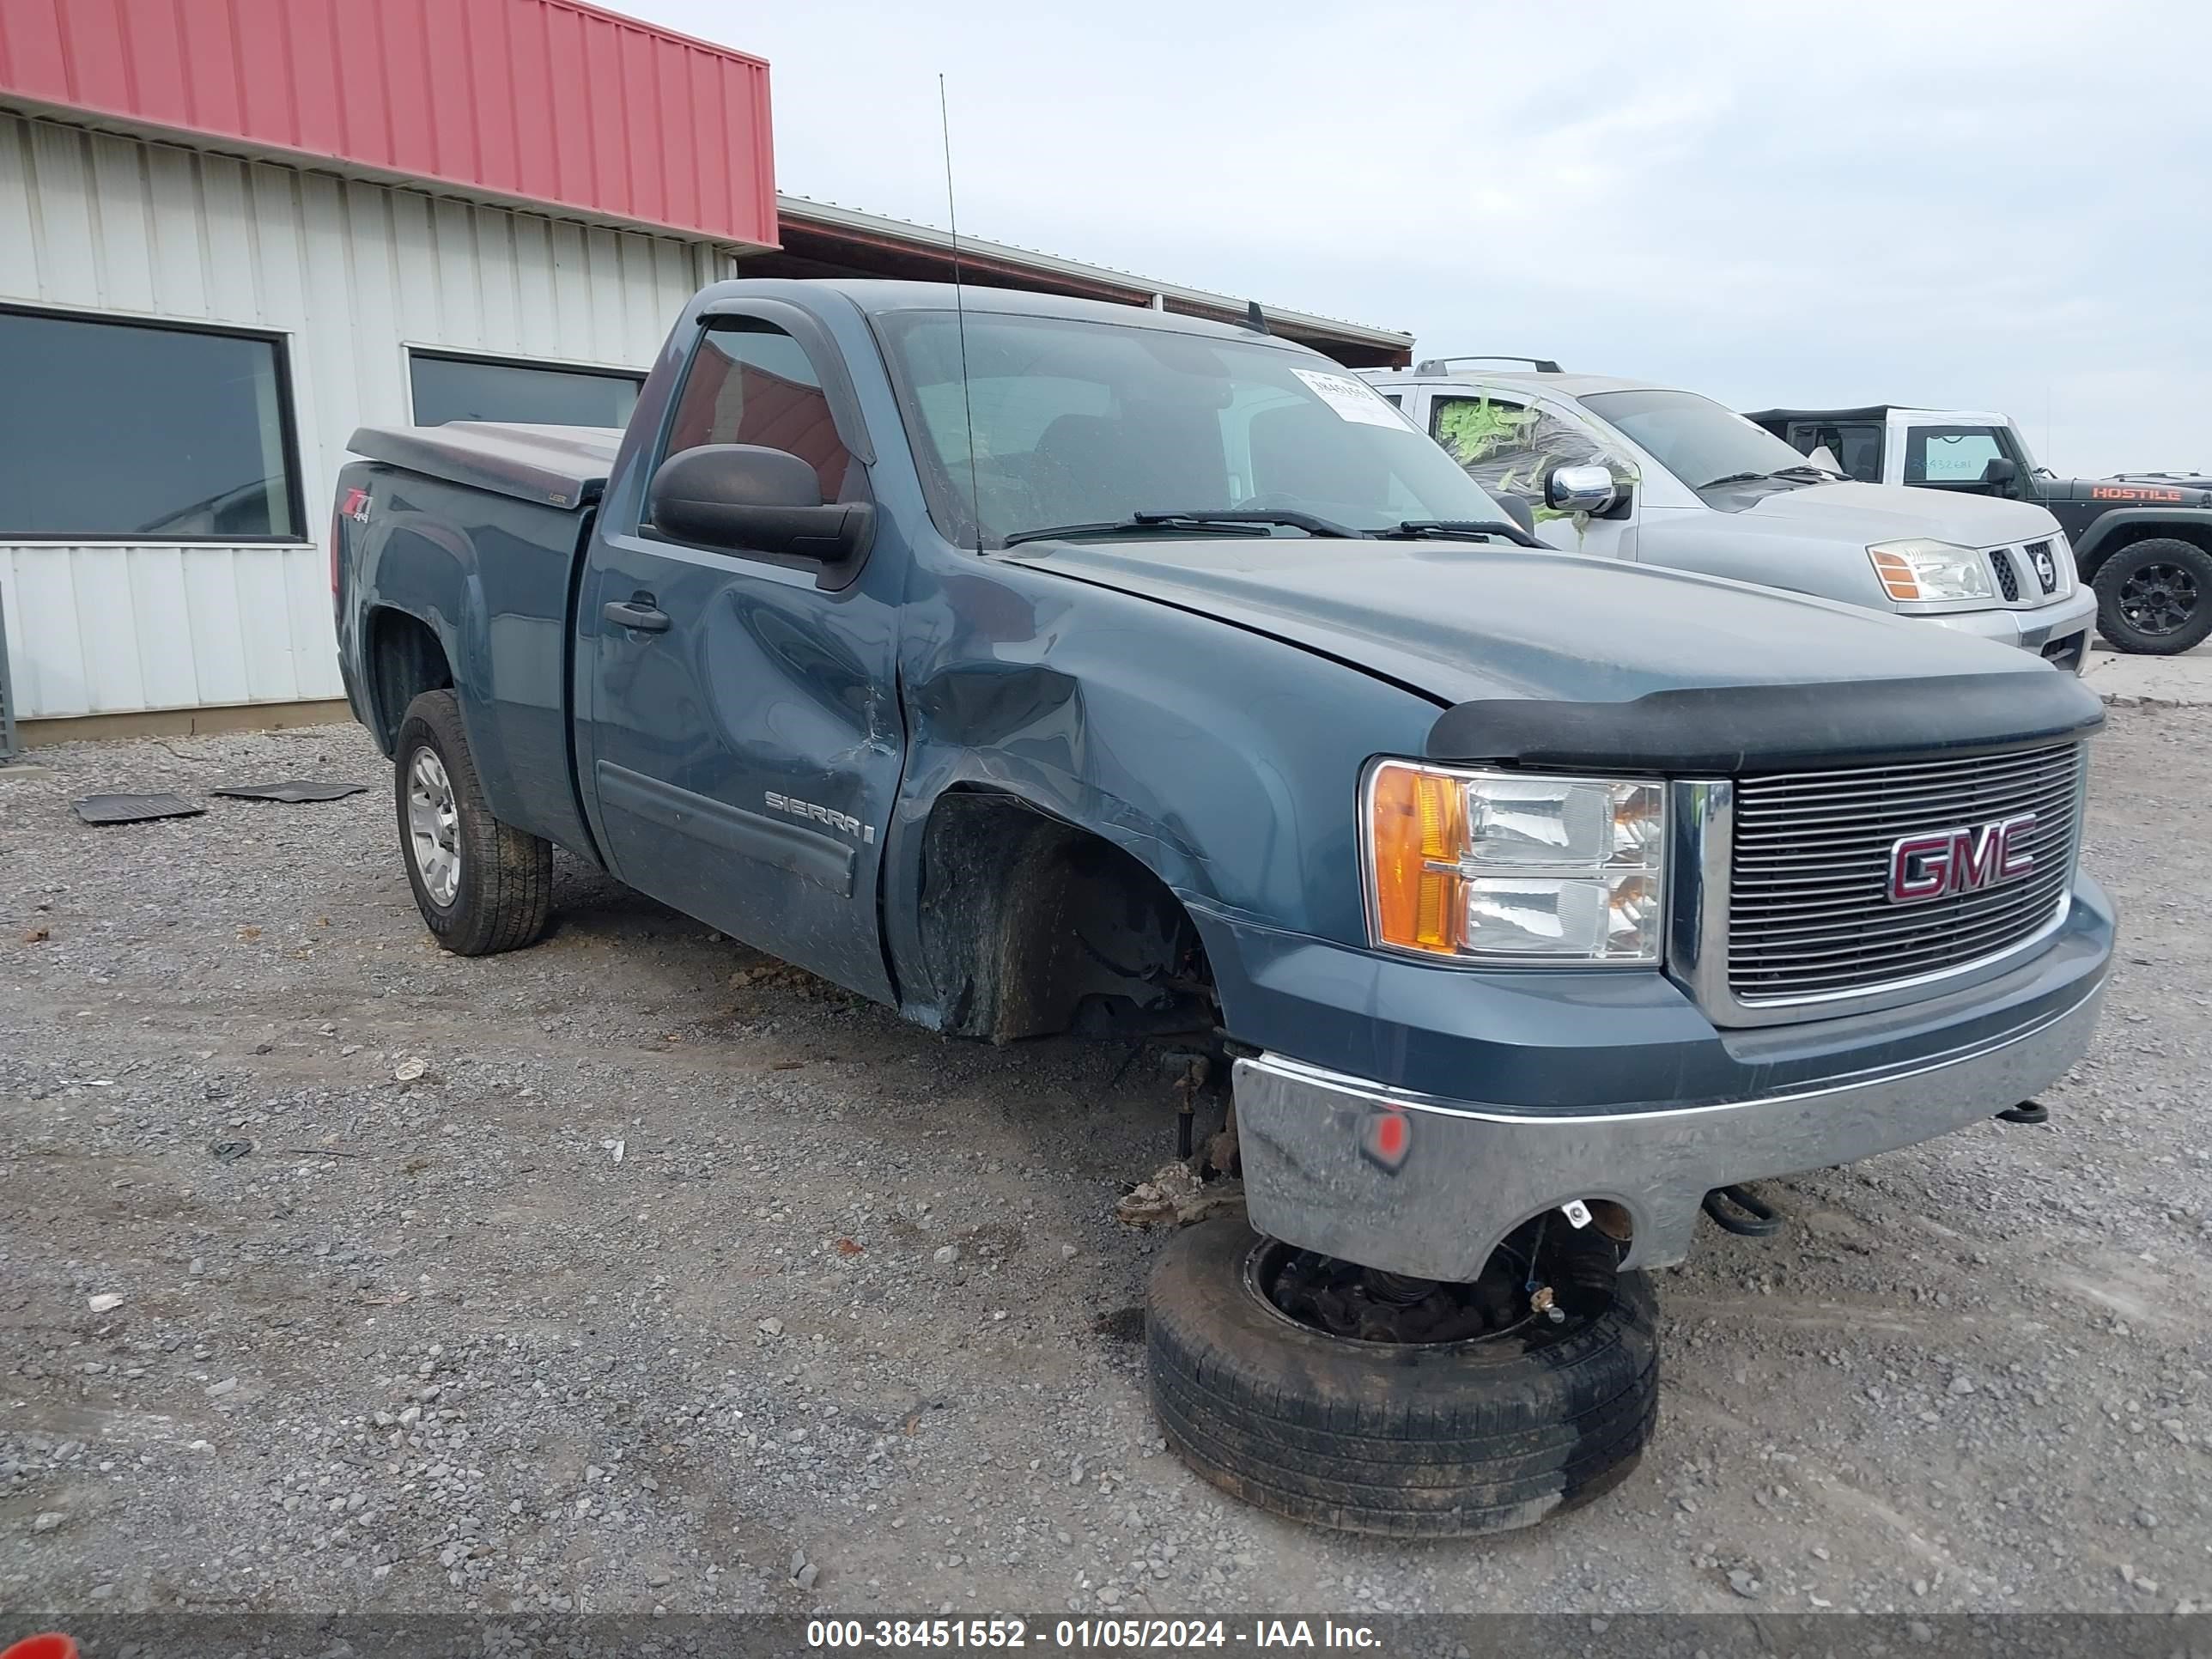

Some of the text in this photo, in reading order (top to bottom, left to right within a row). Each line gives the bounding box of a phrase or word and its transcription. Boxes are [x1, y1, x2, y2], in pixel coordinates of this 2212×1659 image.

[2093, 487, 2181, 501] HOSTILE
[764, 790, 860, 838] SIERRA
[1887, 813, 2037, 904] GMC
